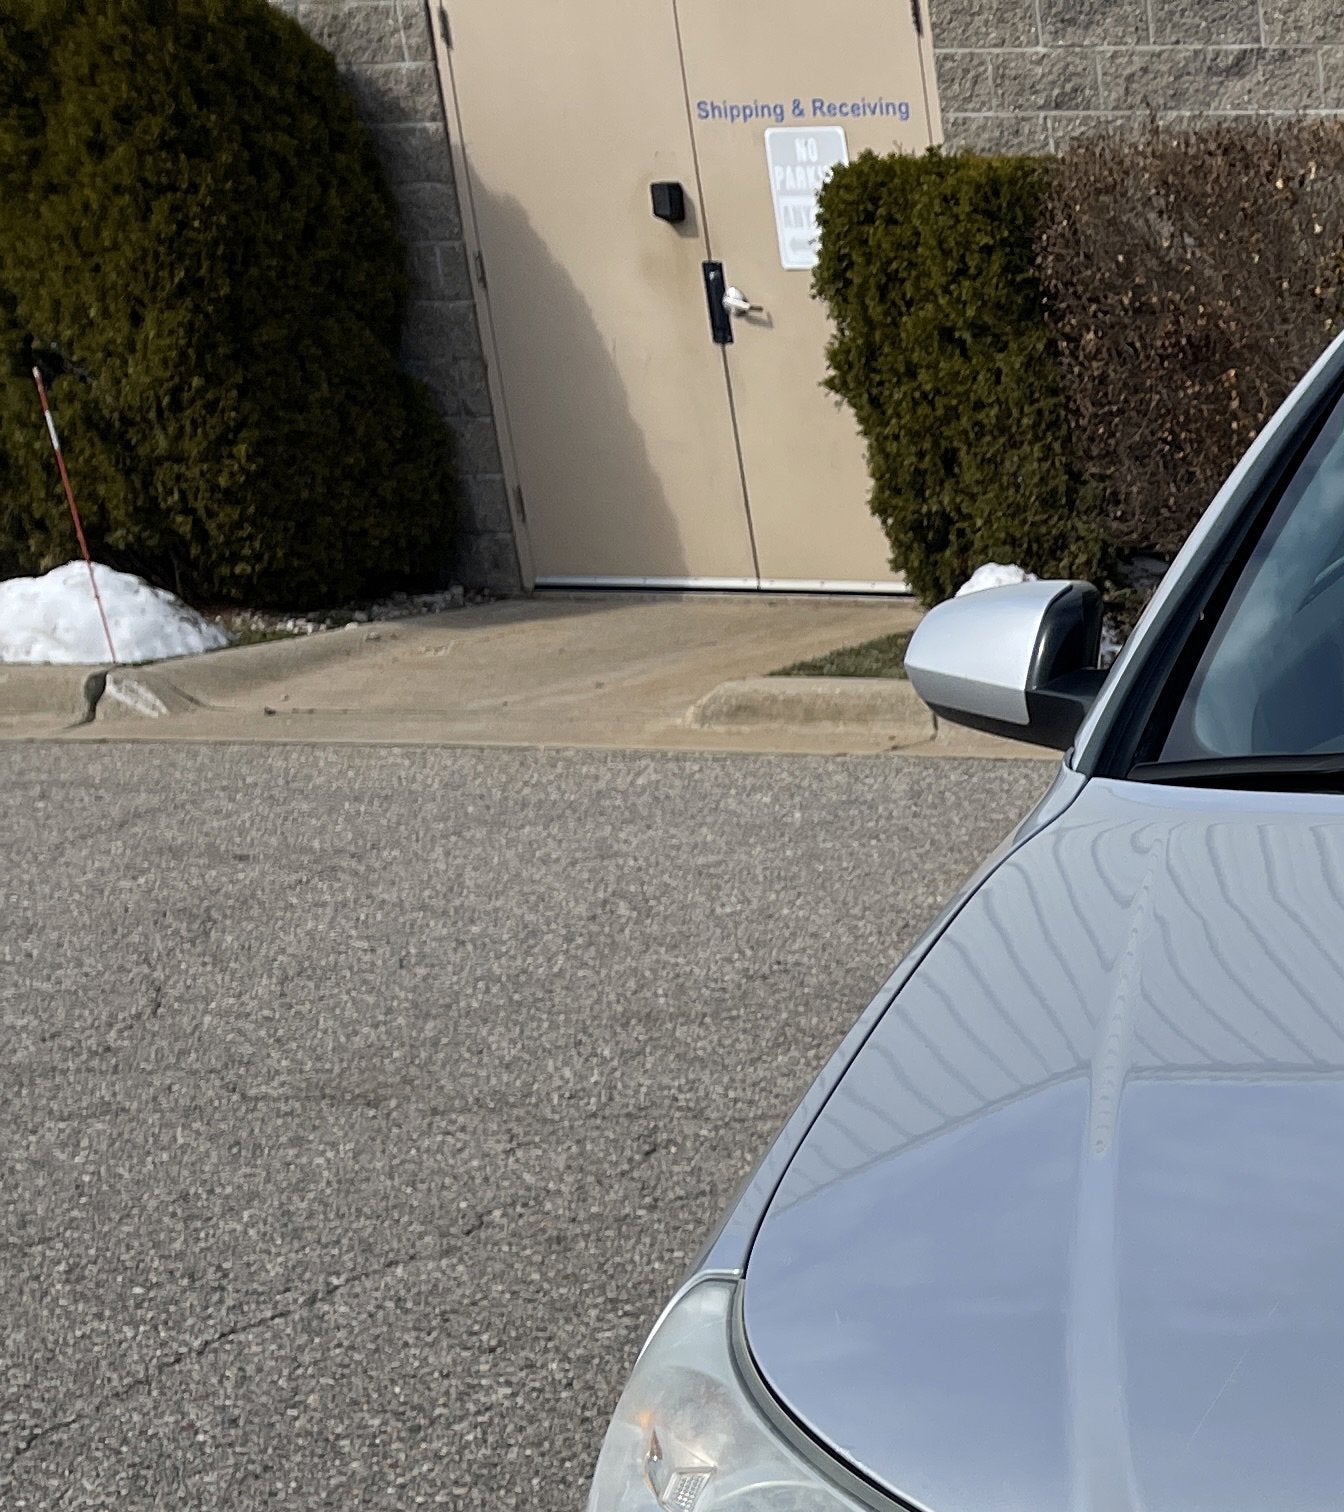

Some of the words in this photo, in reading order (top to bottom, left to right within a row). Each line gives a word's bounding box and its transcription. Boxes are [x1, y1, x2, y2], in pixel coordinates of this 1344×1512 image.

[697, 100, 785, 122] Shipping
[792, 98, 805, 117] &
[811, 97, 910, 121] Receiving
[795, 137, 818, 162] NO
